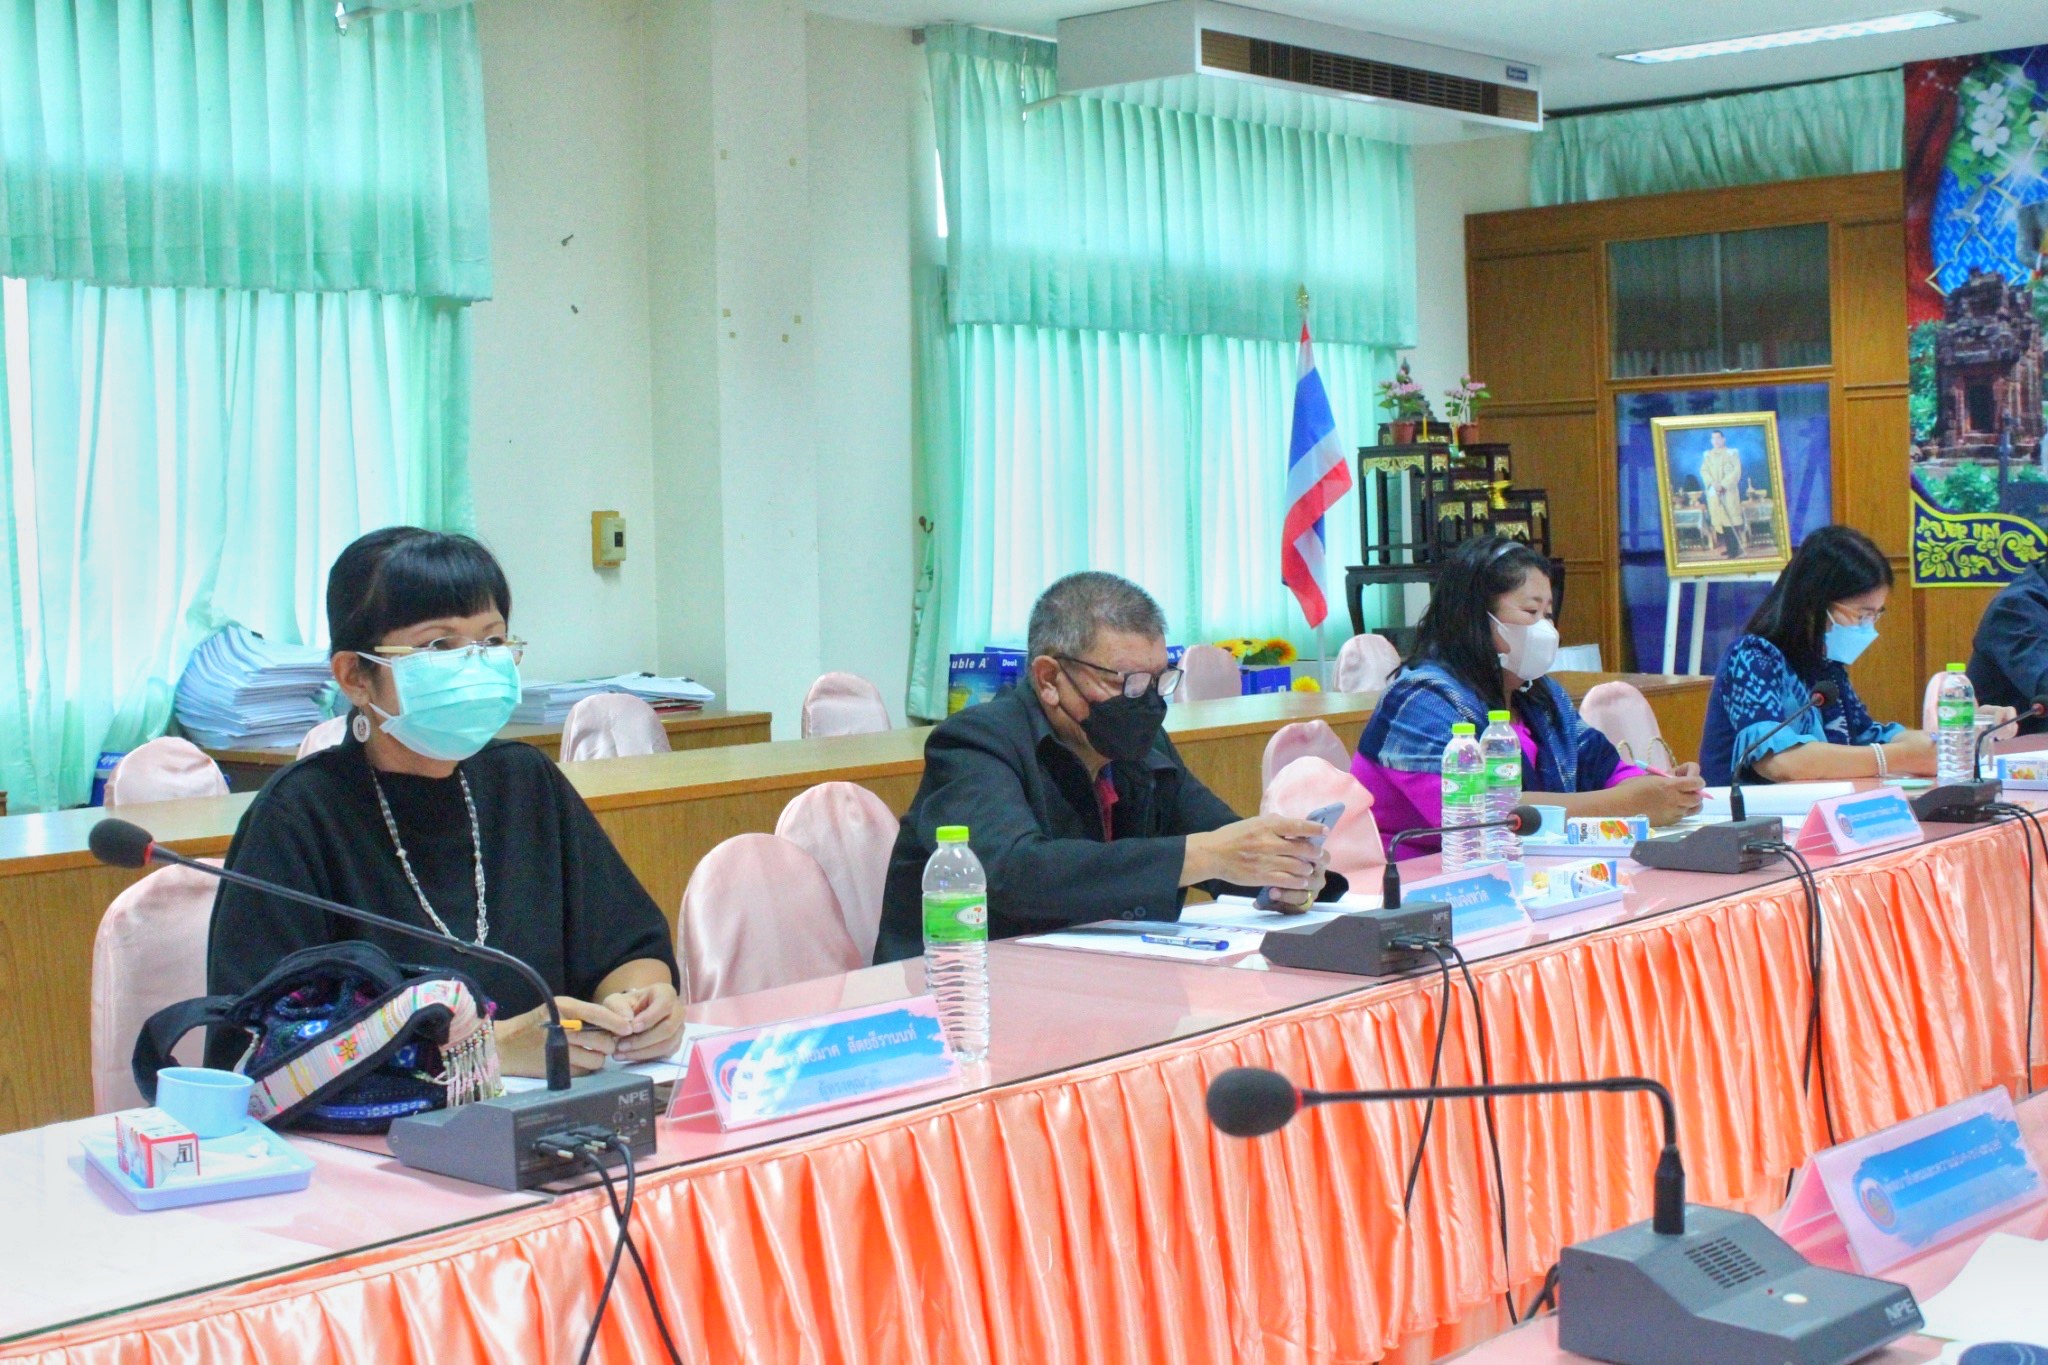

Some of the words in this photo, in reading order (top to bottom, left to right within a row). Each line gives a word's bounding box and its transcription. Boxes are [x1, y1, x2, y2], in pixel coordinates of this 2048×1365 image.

[978, 657, 987, 669] A
[1432, 911, 1450, 921] NPE
[618, 1089, 650, 1106] NPE
[1885, 1298, 1916, 1321] NPE
